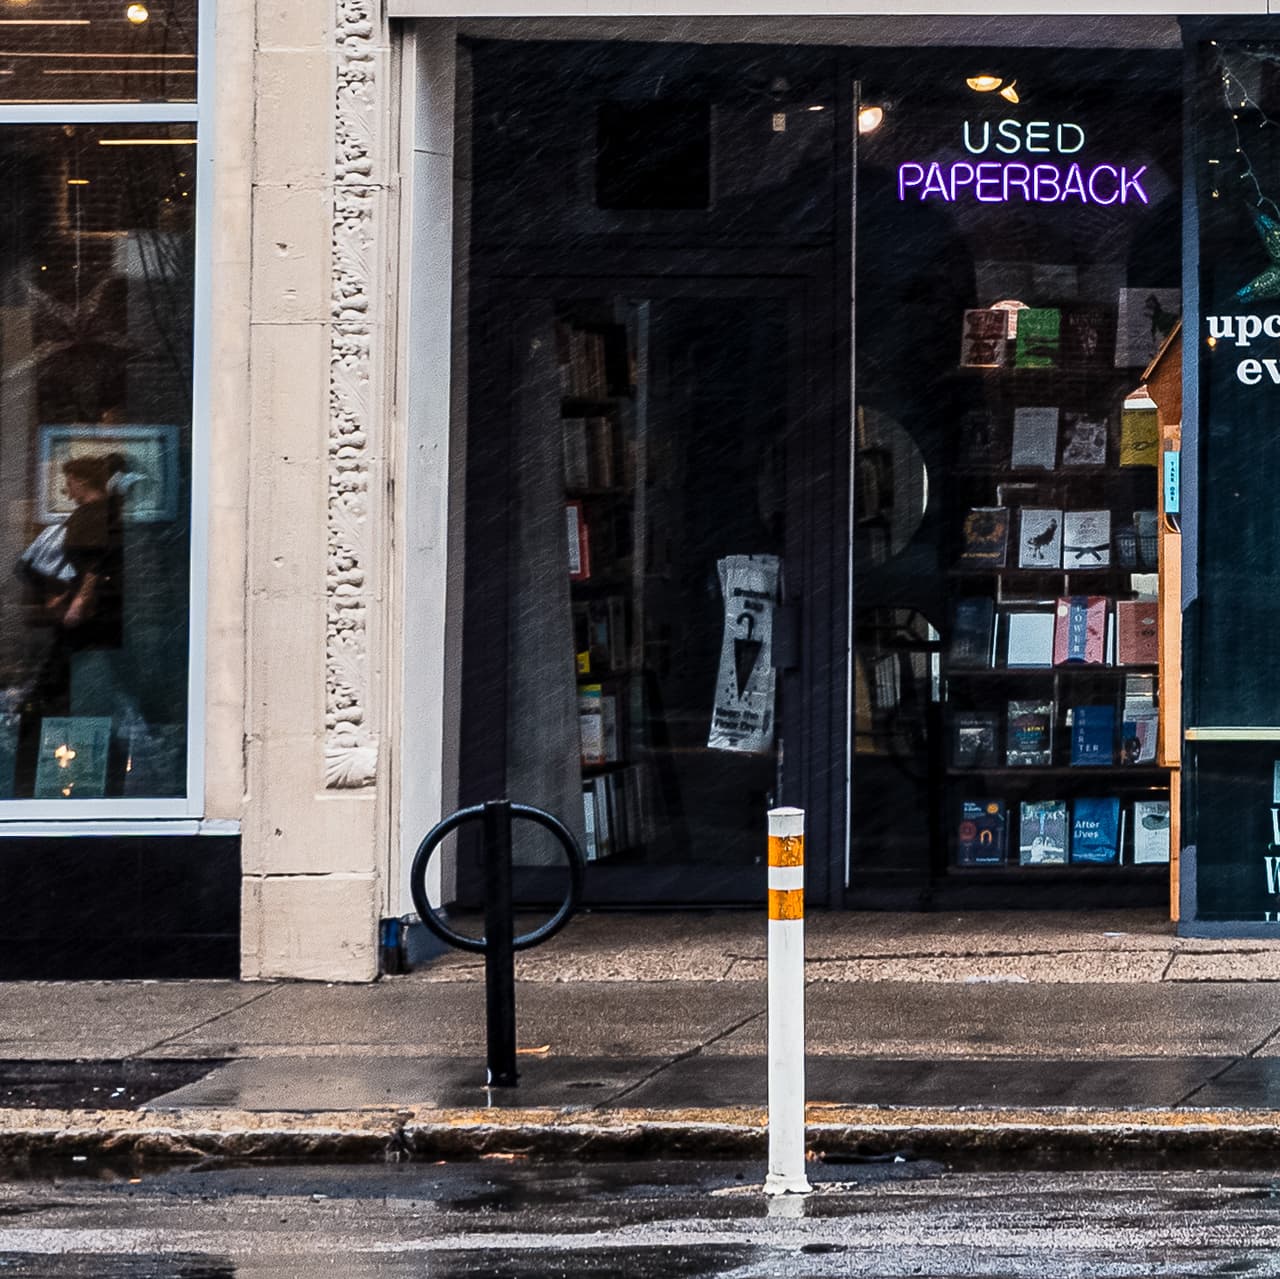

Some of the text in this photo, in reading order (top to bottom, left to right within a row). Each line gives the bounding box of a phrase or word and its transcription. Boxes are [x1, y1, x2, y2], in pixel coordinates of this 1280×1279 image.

[962, 119, 1085, 155] USED
[898, 161, 1149, 205] PAPERBACK
[1073, 830, 1099, 839] Lives
[1074, 821, 1100, 830] After
